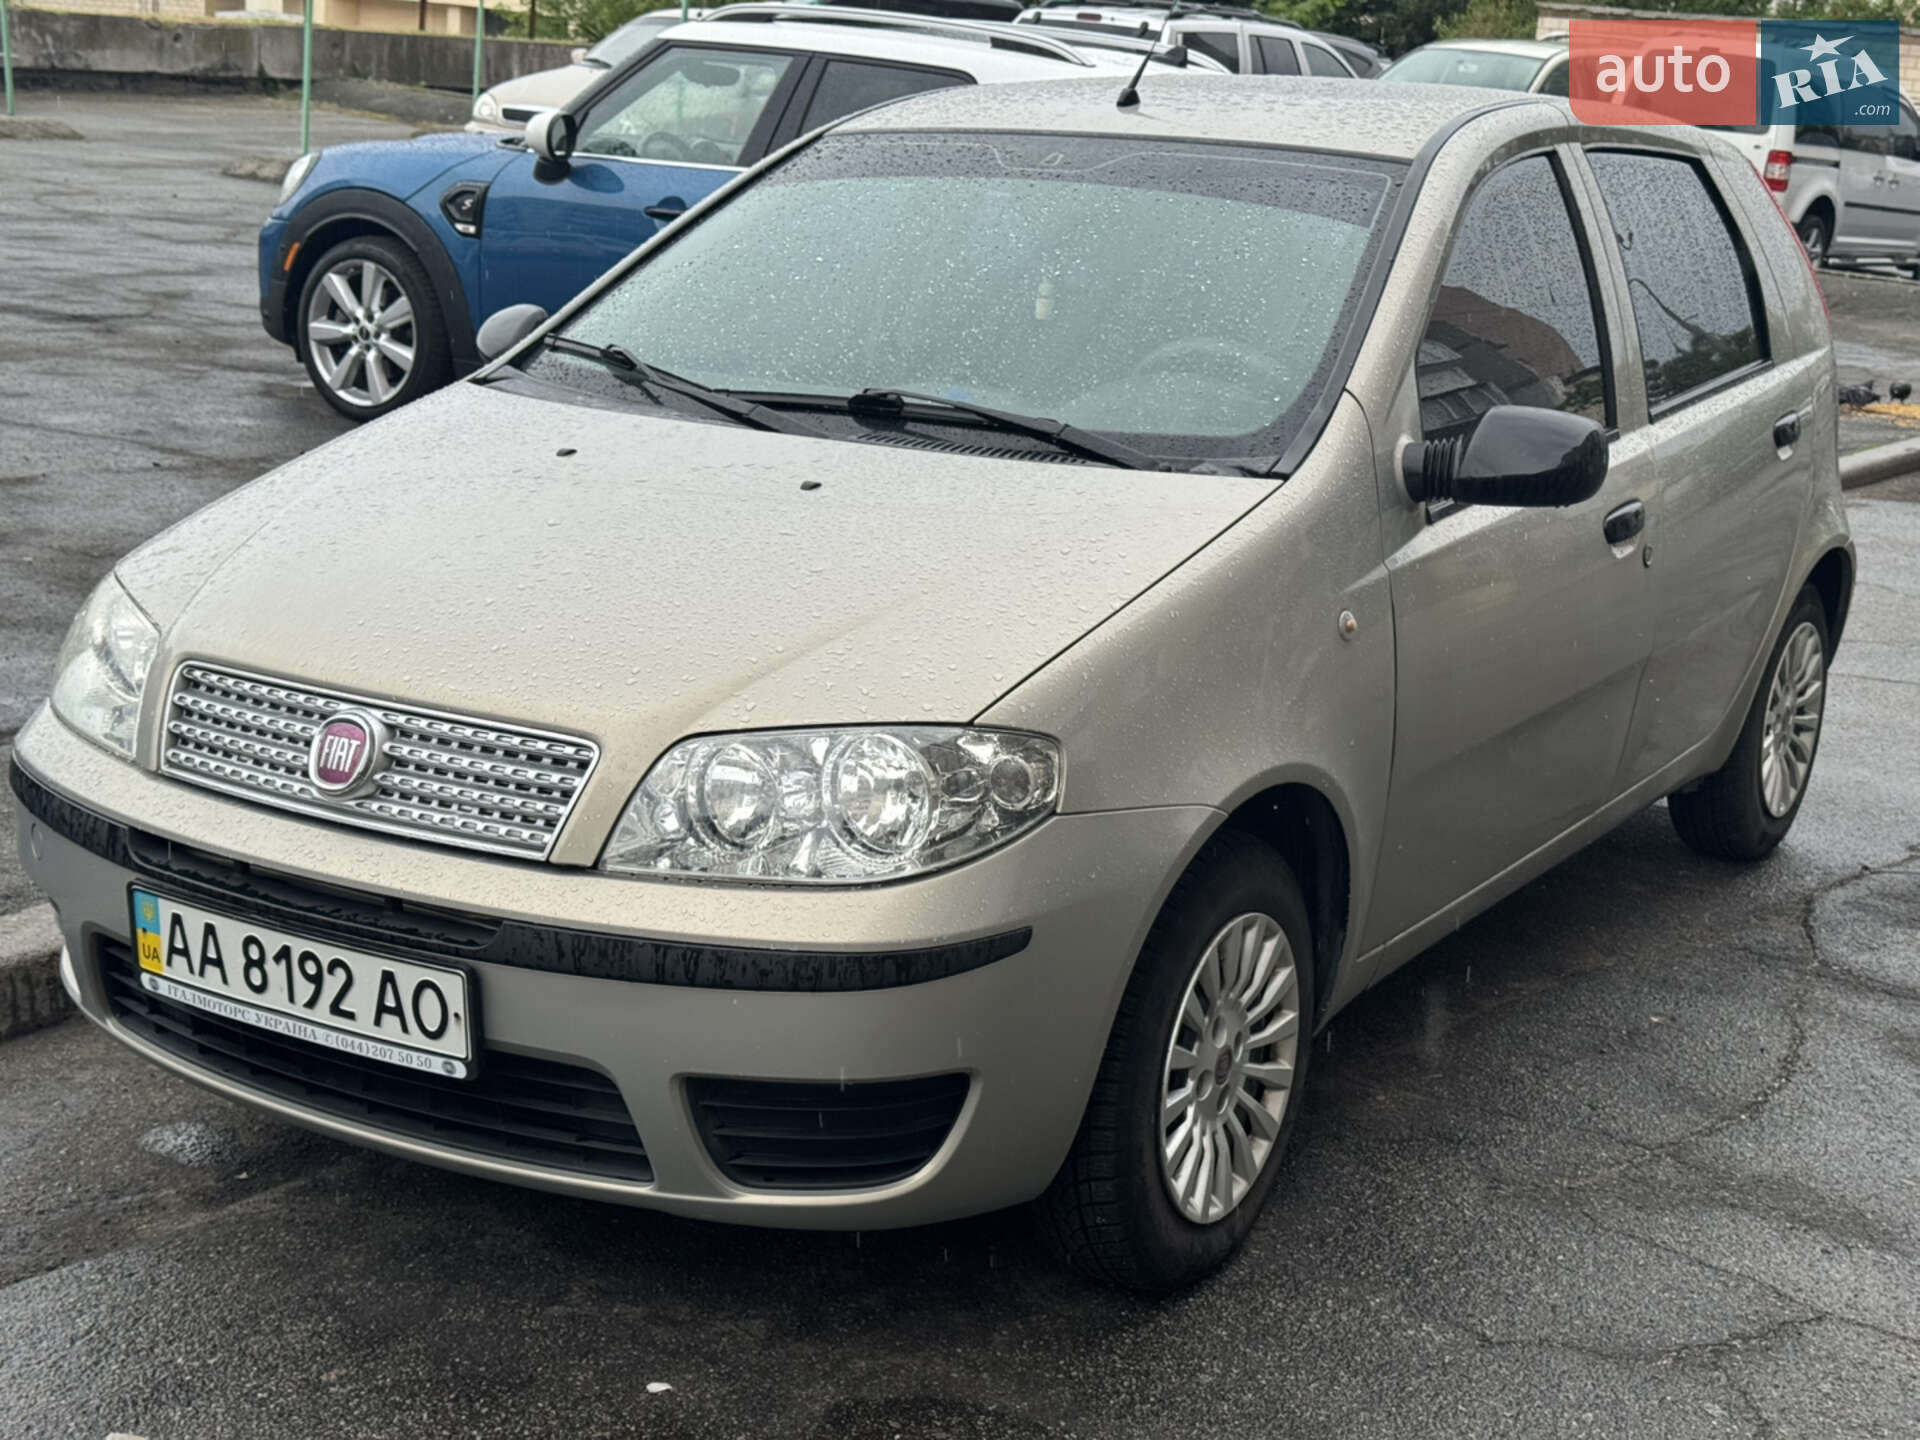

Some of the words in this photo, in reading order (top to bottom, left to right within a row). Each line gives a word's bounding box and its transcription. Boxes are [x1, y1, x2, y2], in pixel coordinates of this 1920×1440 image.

[320, 736, 360, 773] FIAT
[142, 943, 161, 962] UA
[166, 912, 228, 986] AA
[242, 935, 357, 1021] 8192
[373, 970, 449, 1040] AO
[167, 984, 250, 1020] ІТАЛМОТОРС
[397, 1052, 413, 1065] 50
[416, 1057, 432, 1069] 50
